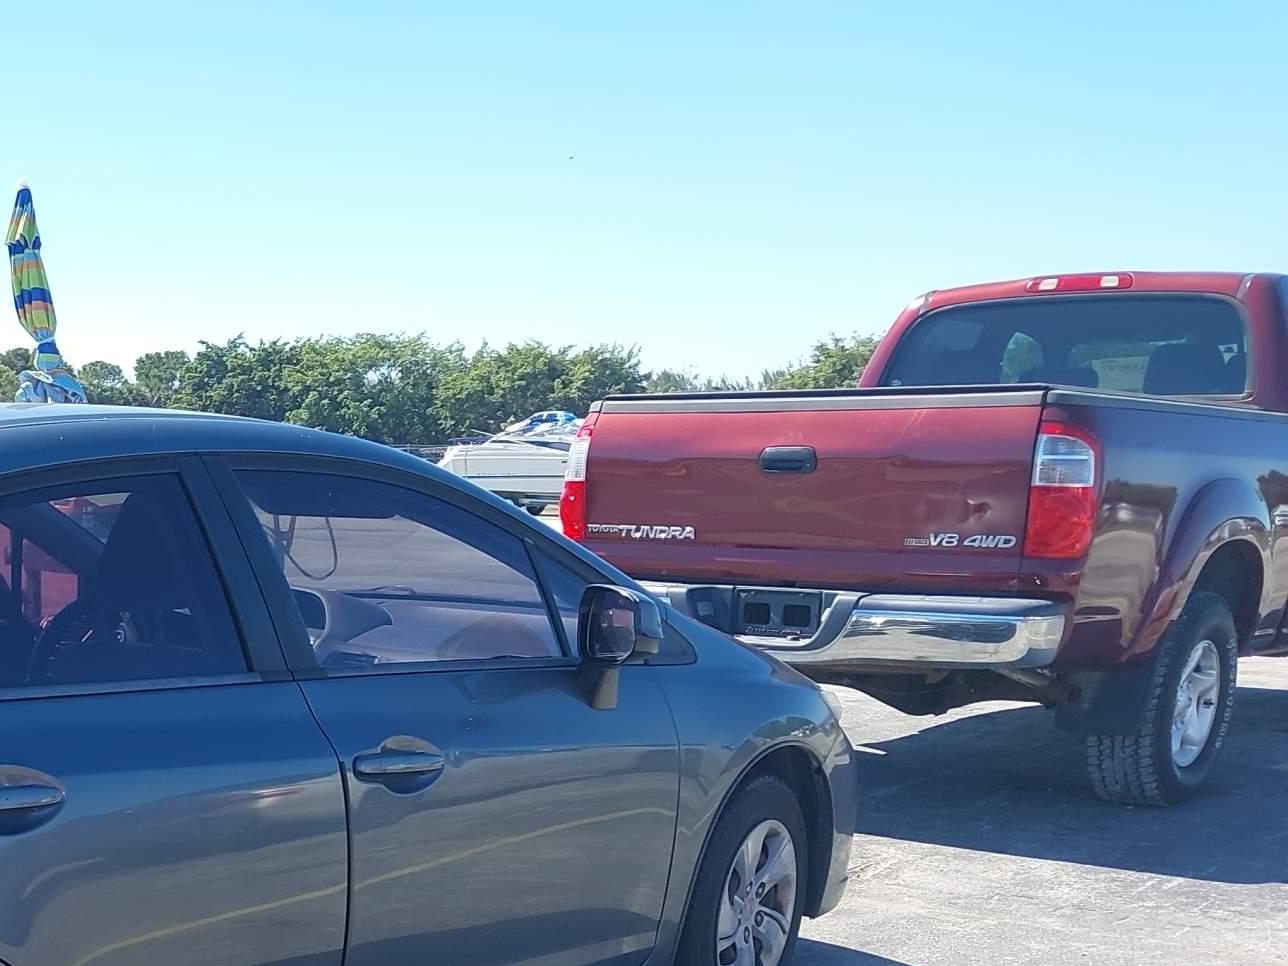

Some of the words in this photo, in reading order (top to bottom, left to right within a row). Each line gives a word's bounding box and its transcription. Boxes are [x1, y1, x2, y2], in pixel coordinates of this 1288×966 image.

[619, 525, 696, 540] TUNDRA
[929, 533, 960, 547] V8
[963, 535, 1017, 548] 4WD
